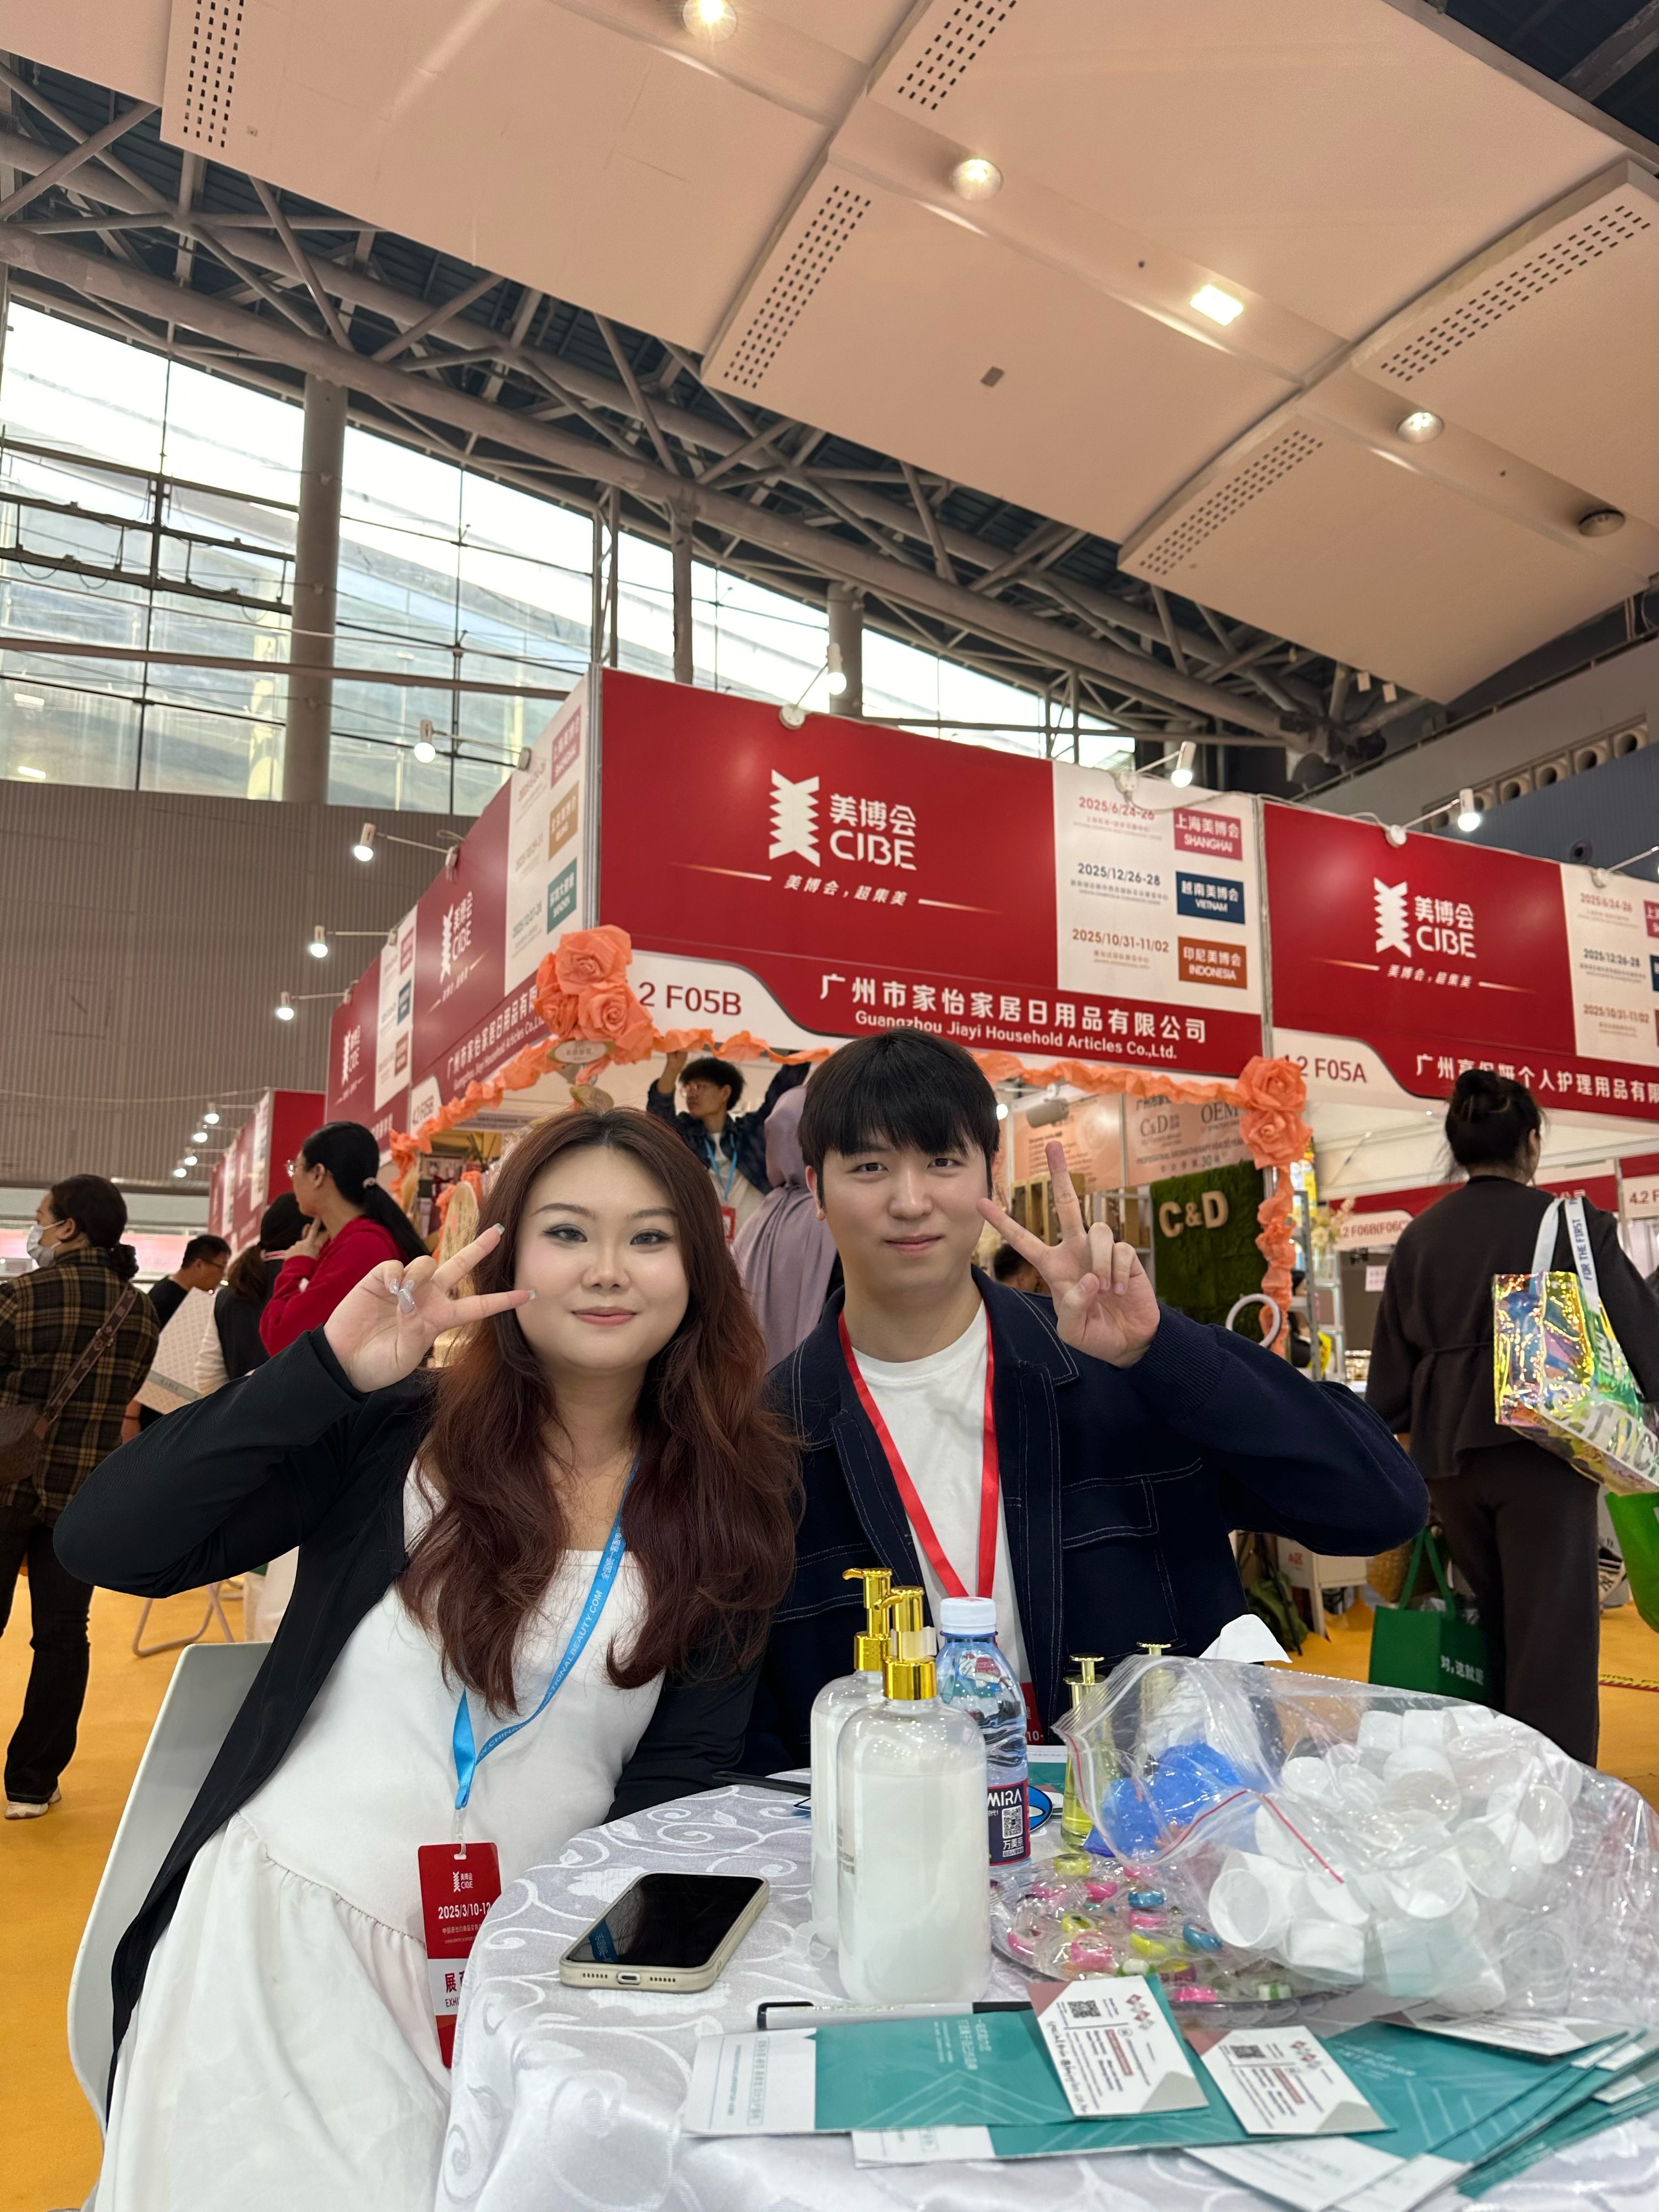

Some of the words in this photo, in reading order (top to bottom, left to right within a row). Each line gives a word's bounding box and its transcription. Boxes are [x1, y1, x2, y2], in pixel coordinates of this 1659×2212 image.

[830, 793, 917, 837] 美博会
[1175, 814, 1240, 839] 上海美博会
[830, 830, 917, 871] CIBE
[1183, 833, 1233, 853] SHANGHAI
[1077, 862, 1161, 887] 2025/12/26-28
[1414, 895, 1475, 930] 美博会
[1072, 928, 1170, 953] 2025/10/31-11/02
[1416, 925, 1477, 959] CIBE
[1188, 963, 1238, 981] INDONESIA
[665, 984, 742, 1016] F05B
[820, 973, 1206, 1043] 广州市家怡家居日用品有限公司
[947, 1020, 981, 1041] Jiayi
[986, 1025, 1063, 1048] Household
[1068, 1035, 1123, 1054] Articles
[1126, 1041, 1177, 1060] Co.,Ltd.
[1314, 1058, 1367, 1084] F05A
[1159, 1190, 1229, 1238] C&D
[1572, 1218, 1585, 1243] FIRST
[1576, 1244, 1589, 1260] THE
